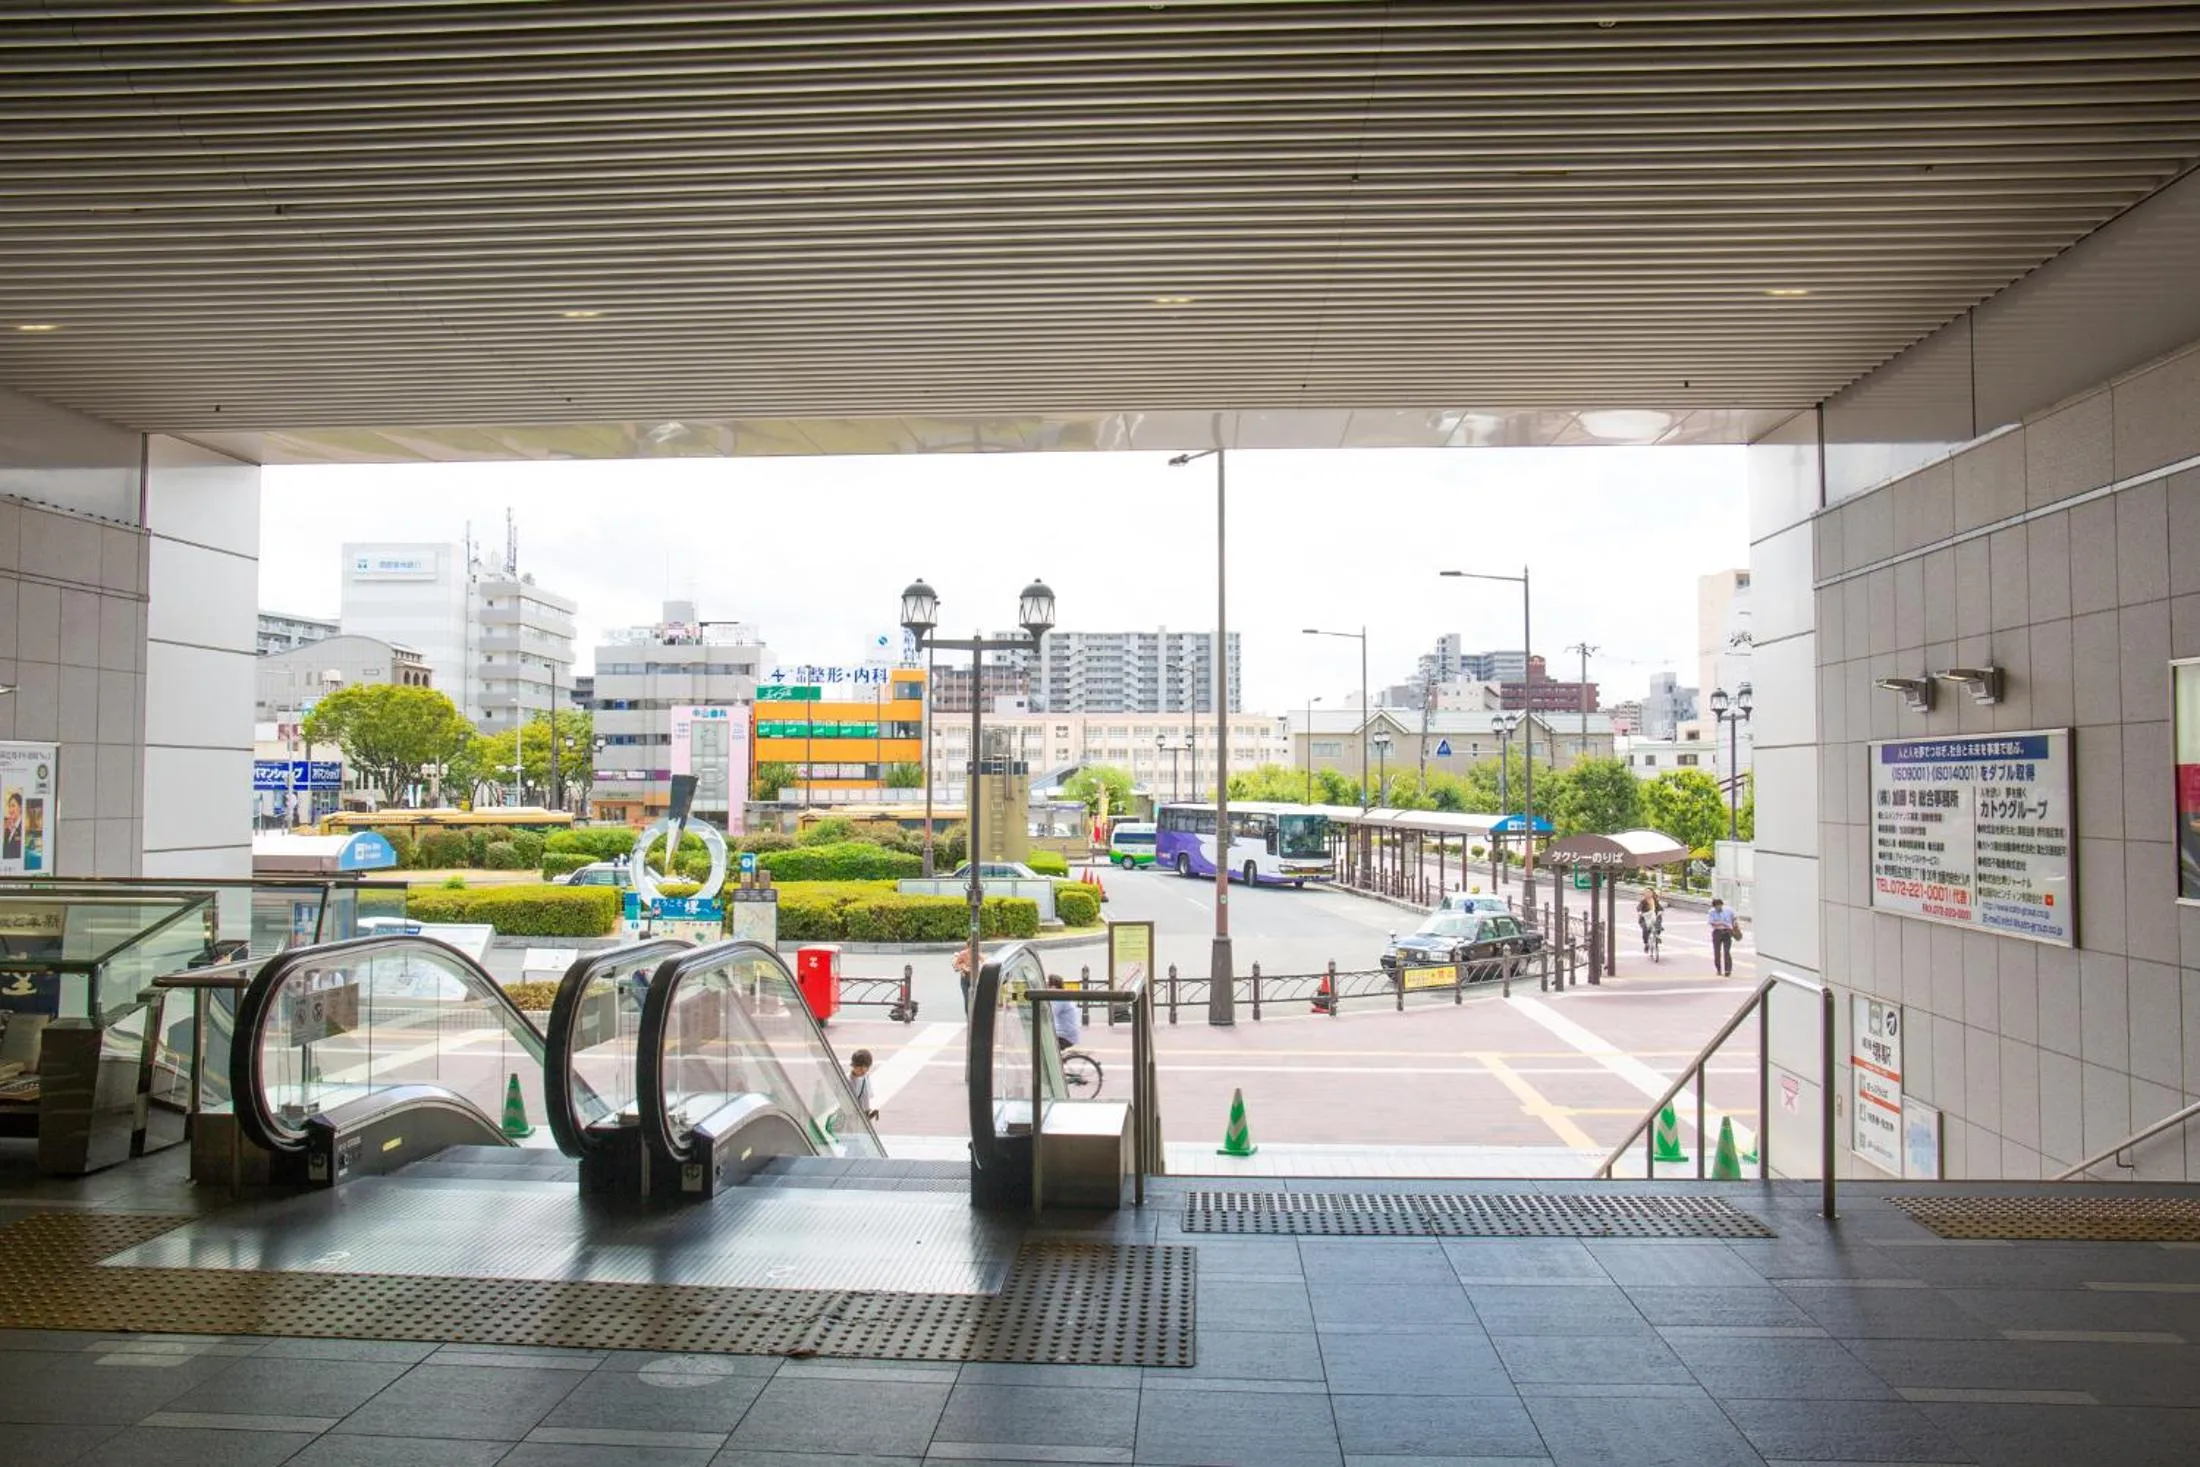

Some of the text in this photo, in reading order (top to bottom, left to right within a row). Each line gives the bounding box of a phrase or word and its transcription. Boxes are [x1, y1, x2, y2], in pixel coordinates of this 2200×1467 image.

[1980, 799, 2048, 820] カトウグループ
[1552, 850, 1625, 865] タクシーのりば
